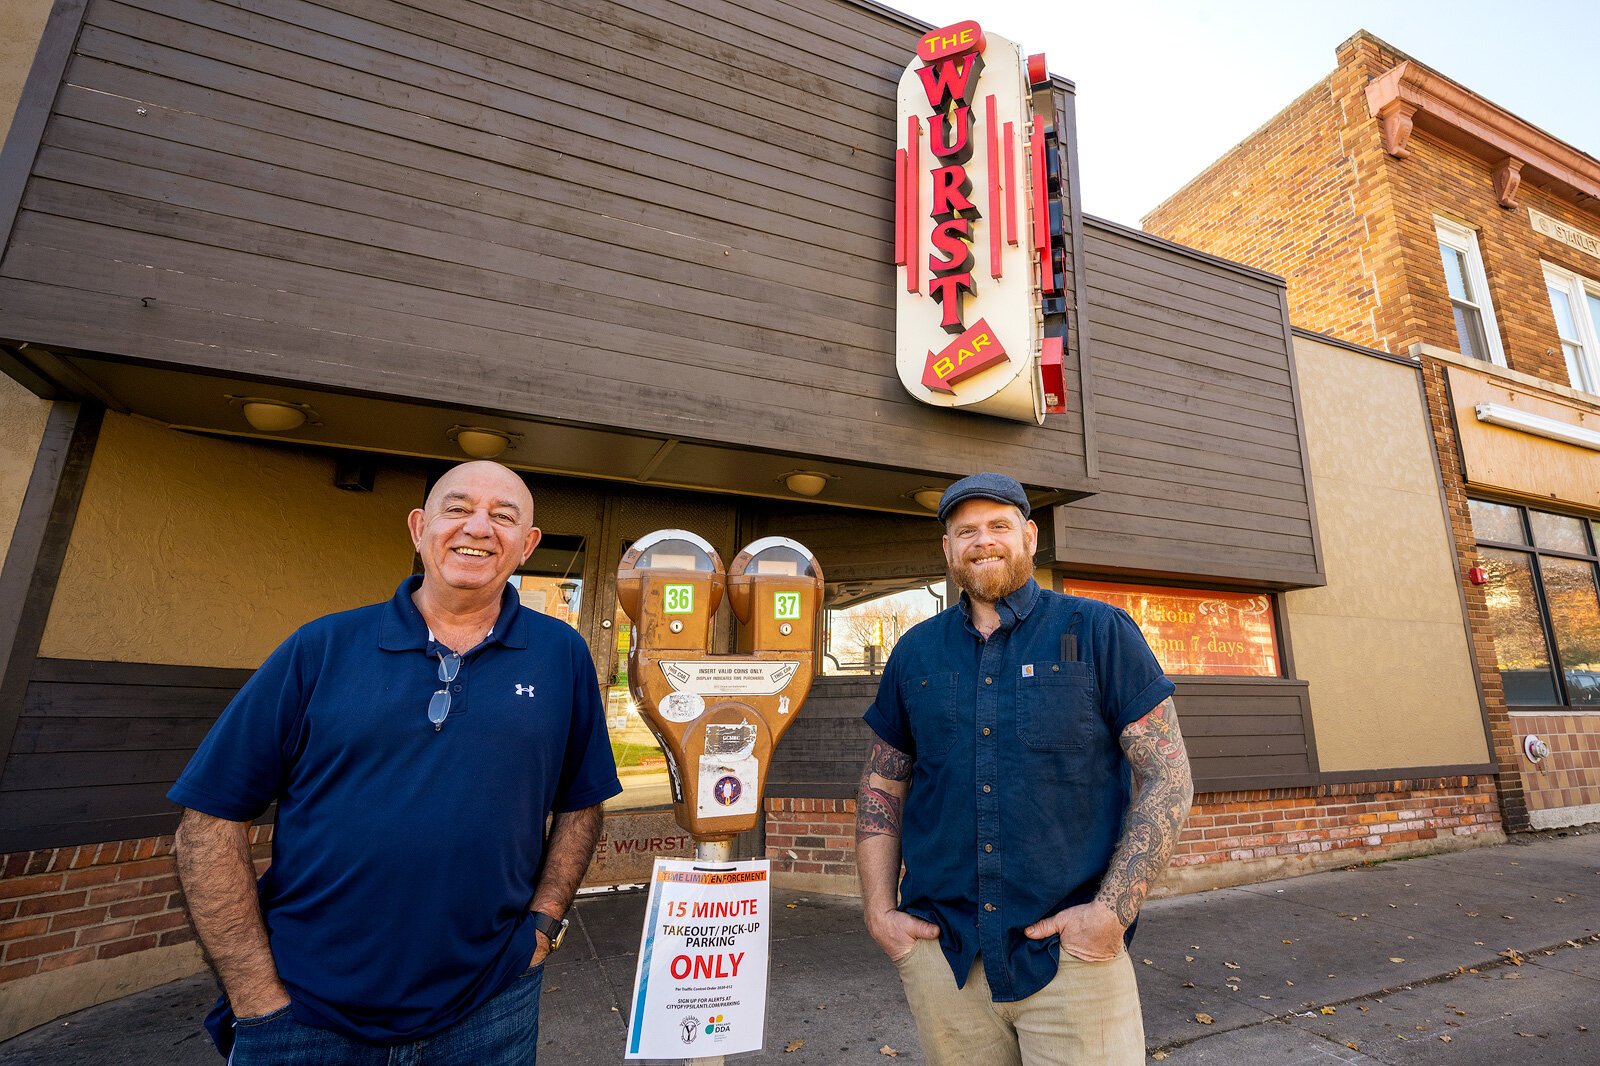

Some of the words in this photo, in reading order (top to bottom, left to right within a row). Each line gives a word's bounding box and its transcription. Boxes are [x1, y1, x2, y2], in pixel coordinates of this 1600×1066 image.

[924, 28, 974, 53] THE
[914, 52, 981, 328] WURST
[931, 332, 992, 379] BAR
[667, 588, 690, 610] 36
[777, 595, 797, 616] 37
[1150, 605, 1196, 624] Hour
[1191, 635, 1201, 652] 7
[1207, 635, 1244, 657] days
[667, 666, 678, 675] THIS
[676, 671, 687, 681] CAR
[774, 671, 784, 680] THIS
[783, 665, 792, 674] CAR
[596, 833, 609, 863] THE
[613, 835, 689, 855] WURST
[662, 872, 684, 881] TIME
[685, 873, 710, 884] LIMIT
[710, 872, 765, 884] ENFORCEMENT
[667, 901, 688, 918] 15
[691, 898, 758, 919] MINUTE
[662, 925, 720, 937] TAKEOUT/
[721, 922, 760, 936] PICK-UP
[685, 936, 736, 948] PARKING
[670, 952, 745, 980] ONLY
[666, 1001, 740, 1009] CITYOFYPSILANTI.COM/PARKING
